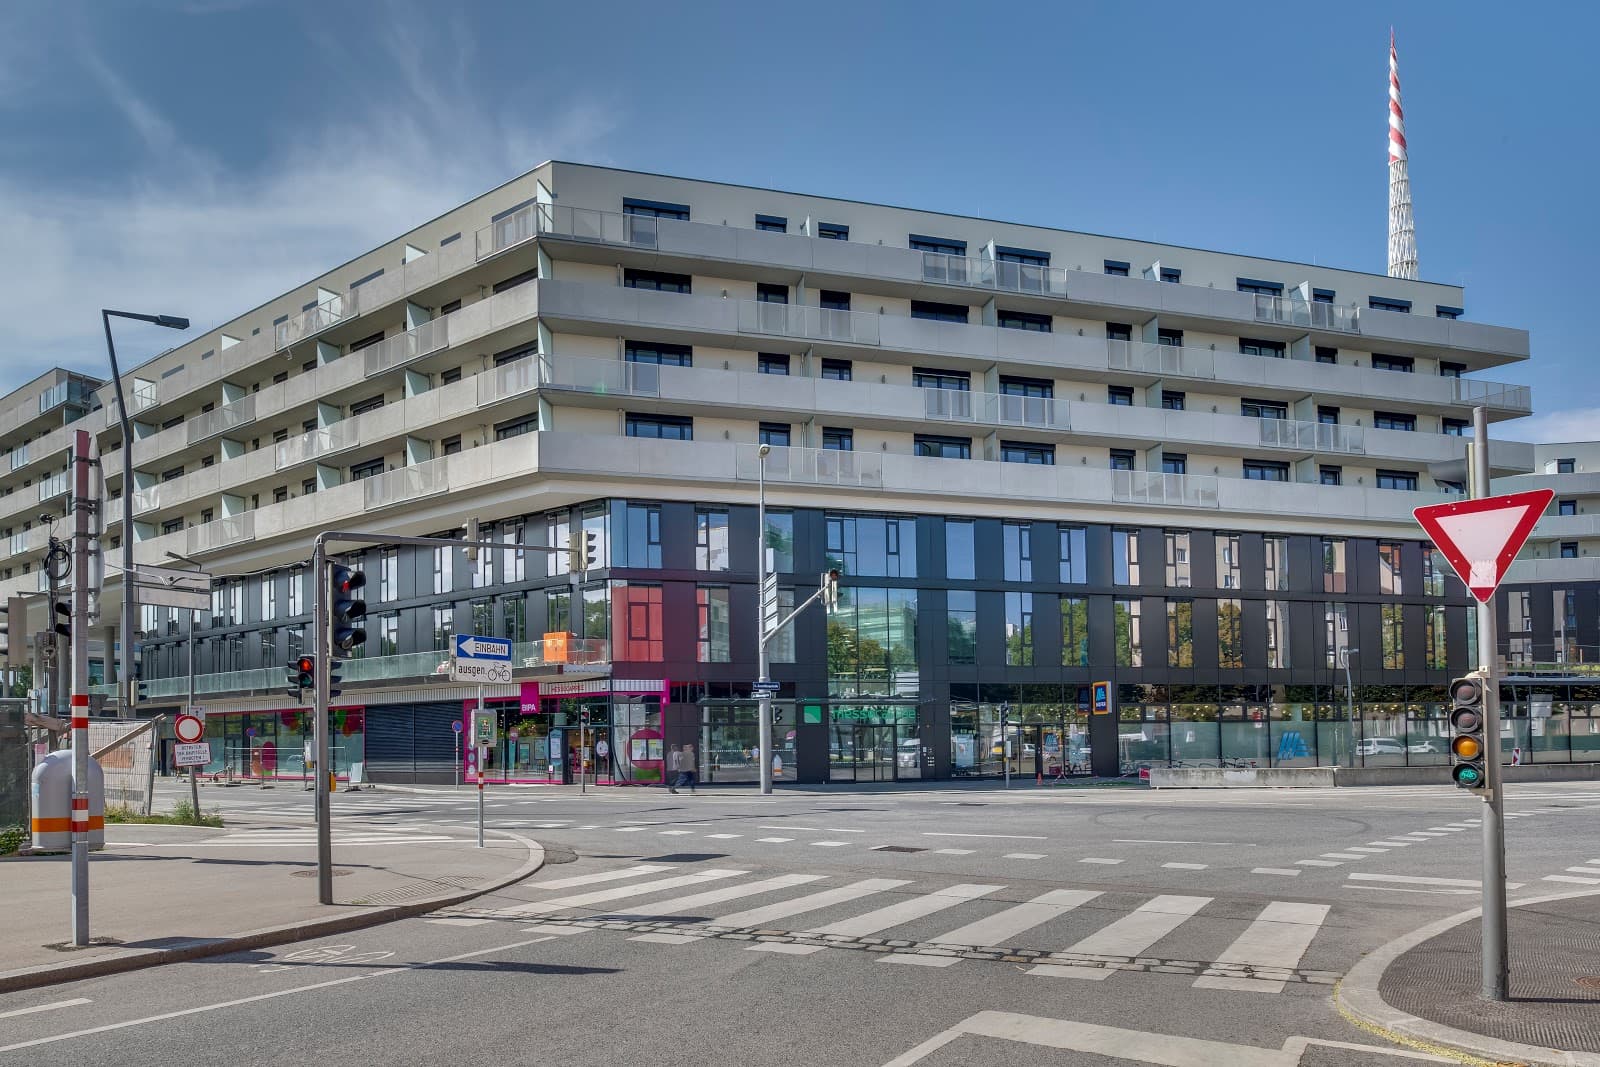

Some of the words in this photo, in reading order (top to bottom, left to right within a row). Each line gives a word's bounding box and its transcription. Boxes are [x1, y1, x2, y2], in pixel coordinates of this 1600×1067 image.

[475, 643, 506, 654] EINBAHN
[458, 665, 487, 677] ausgen.
[521, 703, 537, 712] BIPA
